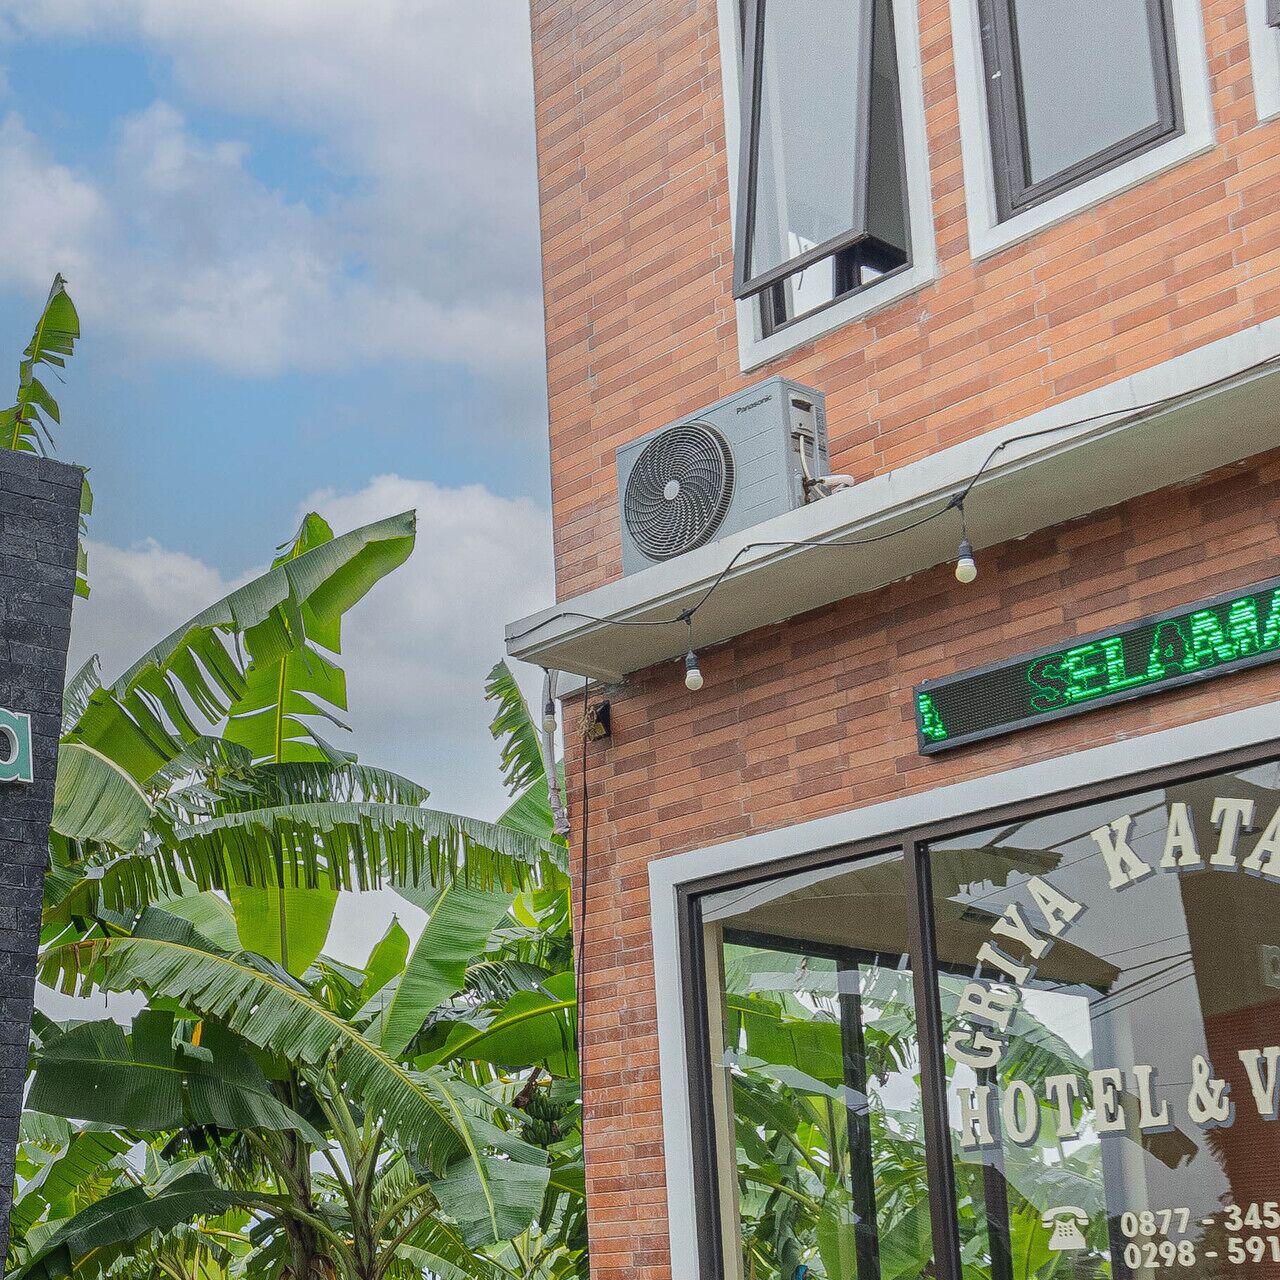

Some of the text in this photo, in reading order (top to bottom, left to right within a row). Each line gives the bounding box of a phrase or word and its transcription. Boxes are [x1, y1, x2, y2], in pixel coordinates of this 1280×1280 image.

[736, 395, 772, 414] Panasonic
[946, 876, 1087, 1069] GRIYA
[956, 1064, 1171, 1149] HOTEL
[1187, 1054, 1232, 1126] &
